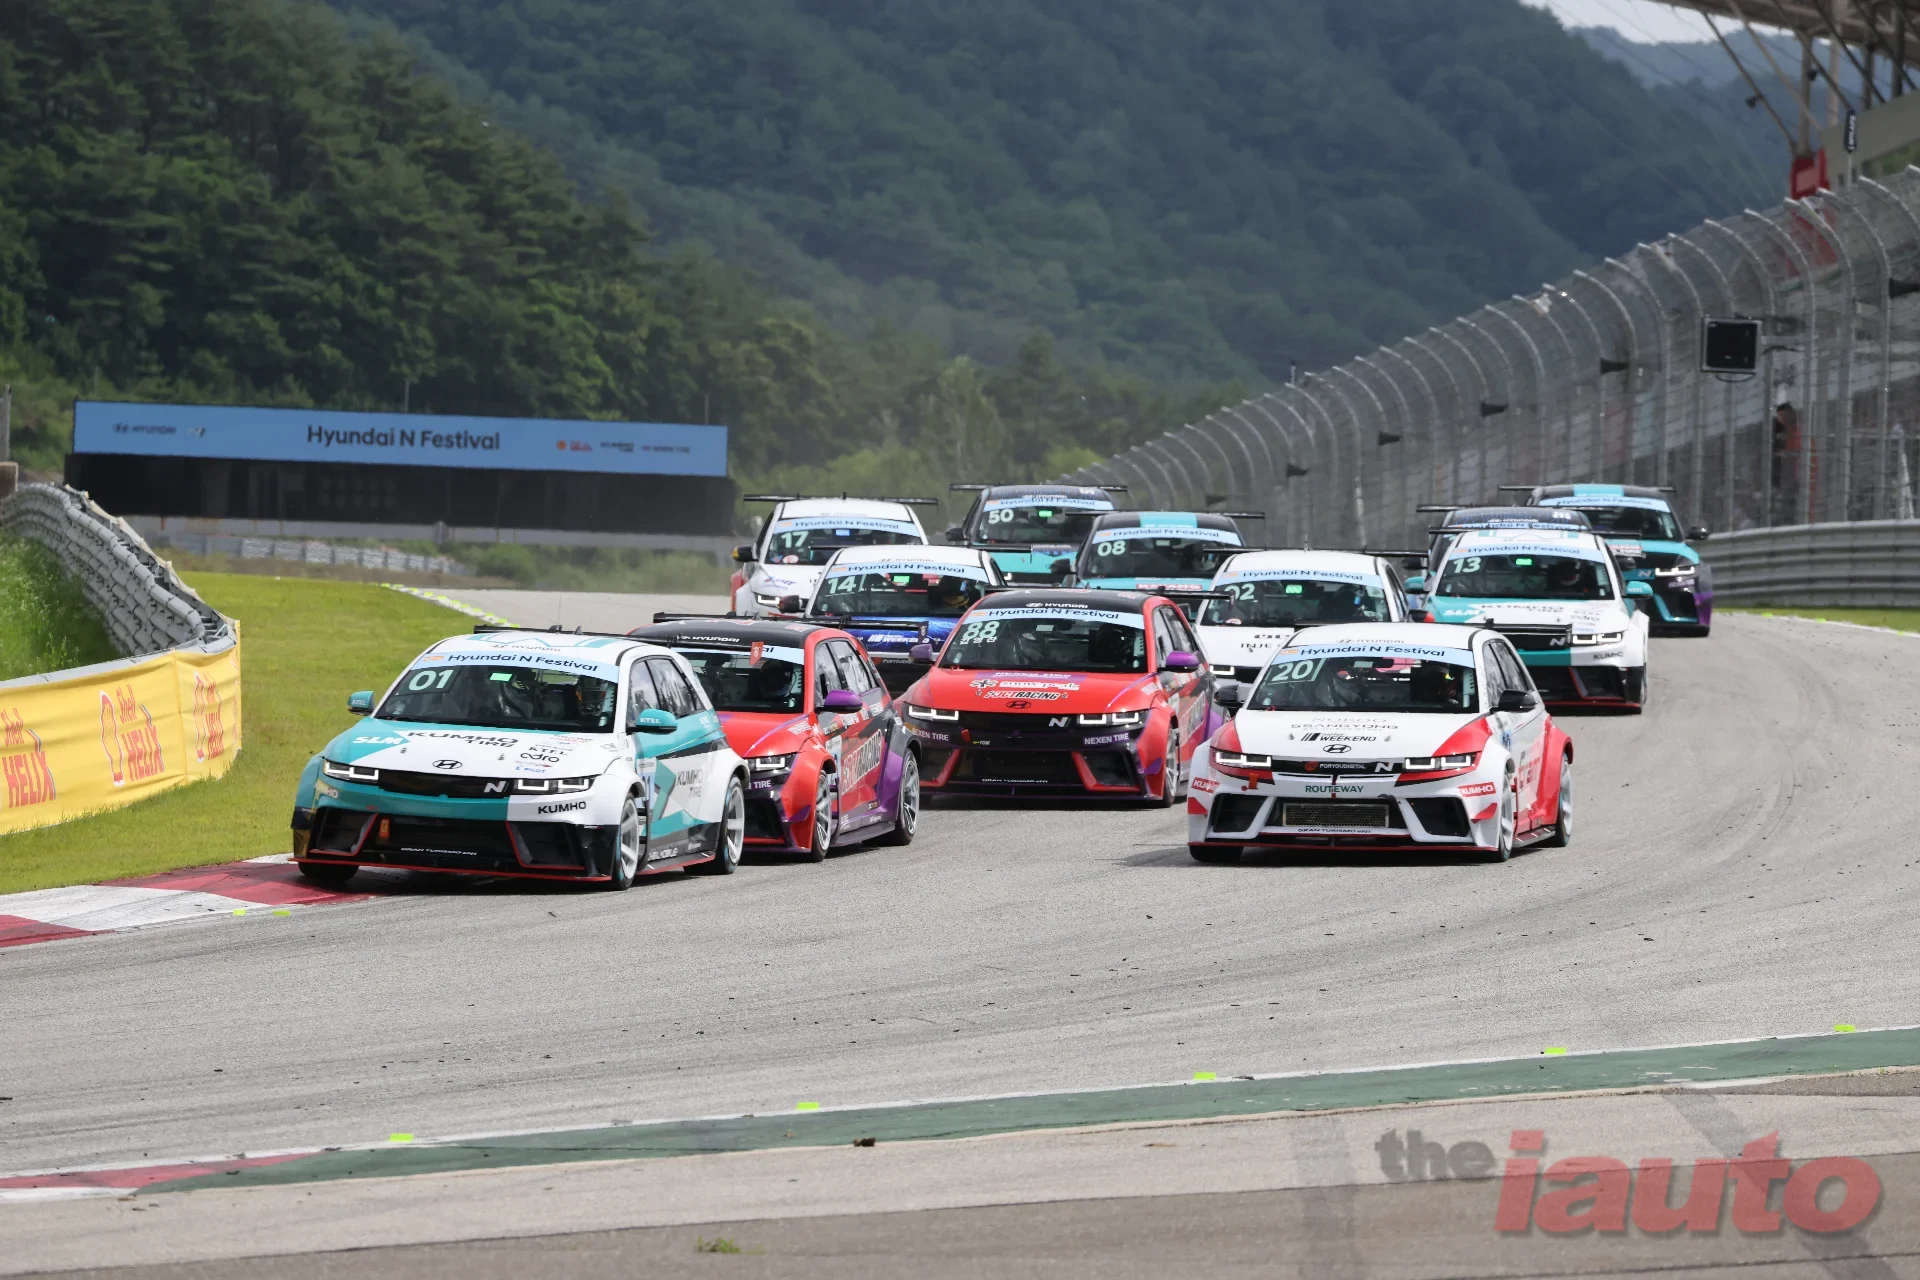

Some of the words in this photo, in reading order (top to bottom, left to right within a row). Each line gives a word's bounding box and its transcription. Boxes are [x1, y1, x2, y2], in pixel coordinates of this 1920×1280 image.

[307, 425, 395, 447] Hyundai
[400, 429, 415, 447] N
[420, 430, 500, 450] Festival
[988, 508, 1014, 525] 50
[781, 530, 809, 549] 17
[1113, 528, 1162, 536] Hyundai
[1175, 529, 1220, 538] Festival
[1097, 540, 1126, 557] 08
[848, 563, 901, 571] Hyundai
[917, 564, 965, 573] Festival
[1453, 556, 1482, 574] 13
[1243, 569, 1298, 579] Hyundai
[1313, 570, 1363, 580] Festival
[827, 575, 857, 595] 14
[1223, 583, 1256, 602] 02
[988, 608, 1048, 616] Hyundai
[1064, 609, 1119, 619] Festival
[962, 620, 999, 640] 88
[1300, 646, 1366, 656] Hyundai
[1385, 646, 1446, 657] Festival
[448, 653, 516, 662] Hyundai
[519, 655, 531, 663] N
[535, 656, 598, 672] Festival
[1271, 659, 1314, 683] 20
[408, 669, 454, 691] 01
[1048, 716, 1069, 728] N
[352, 736, 404, 745] SLM
[407, 731, 519, 743] KUMHO
[931, 732, 949, 741] TIRE
[1084, 735, 1113, 745] NEXEN
[1113, 732, 1130, 742] TIRE
[464, 739, 515, 748] TIRE
[121, 724, 165, 782] HELIX
[1374, 762, 1395, 773] N
[1, 750, 55, 808] HELIX
[753, 779, 772, 789] TIRE
[483, 780, 507, 793] N
[1305, 785, 1365, 793] ROUTEWAY
[1459, 784, 1495, 795] KUMHO
[538, 801, 587, 815] KUMHO
